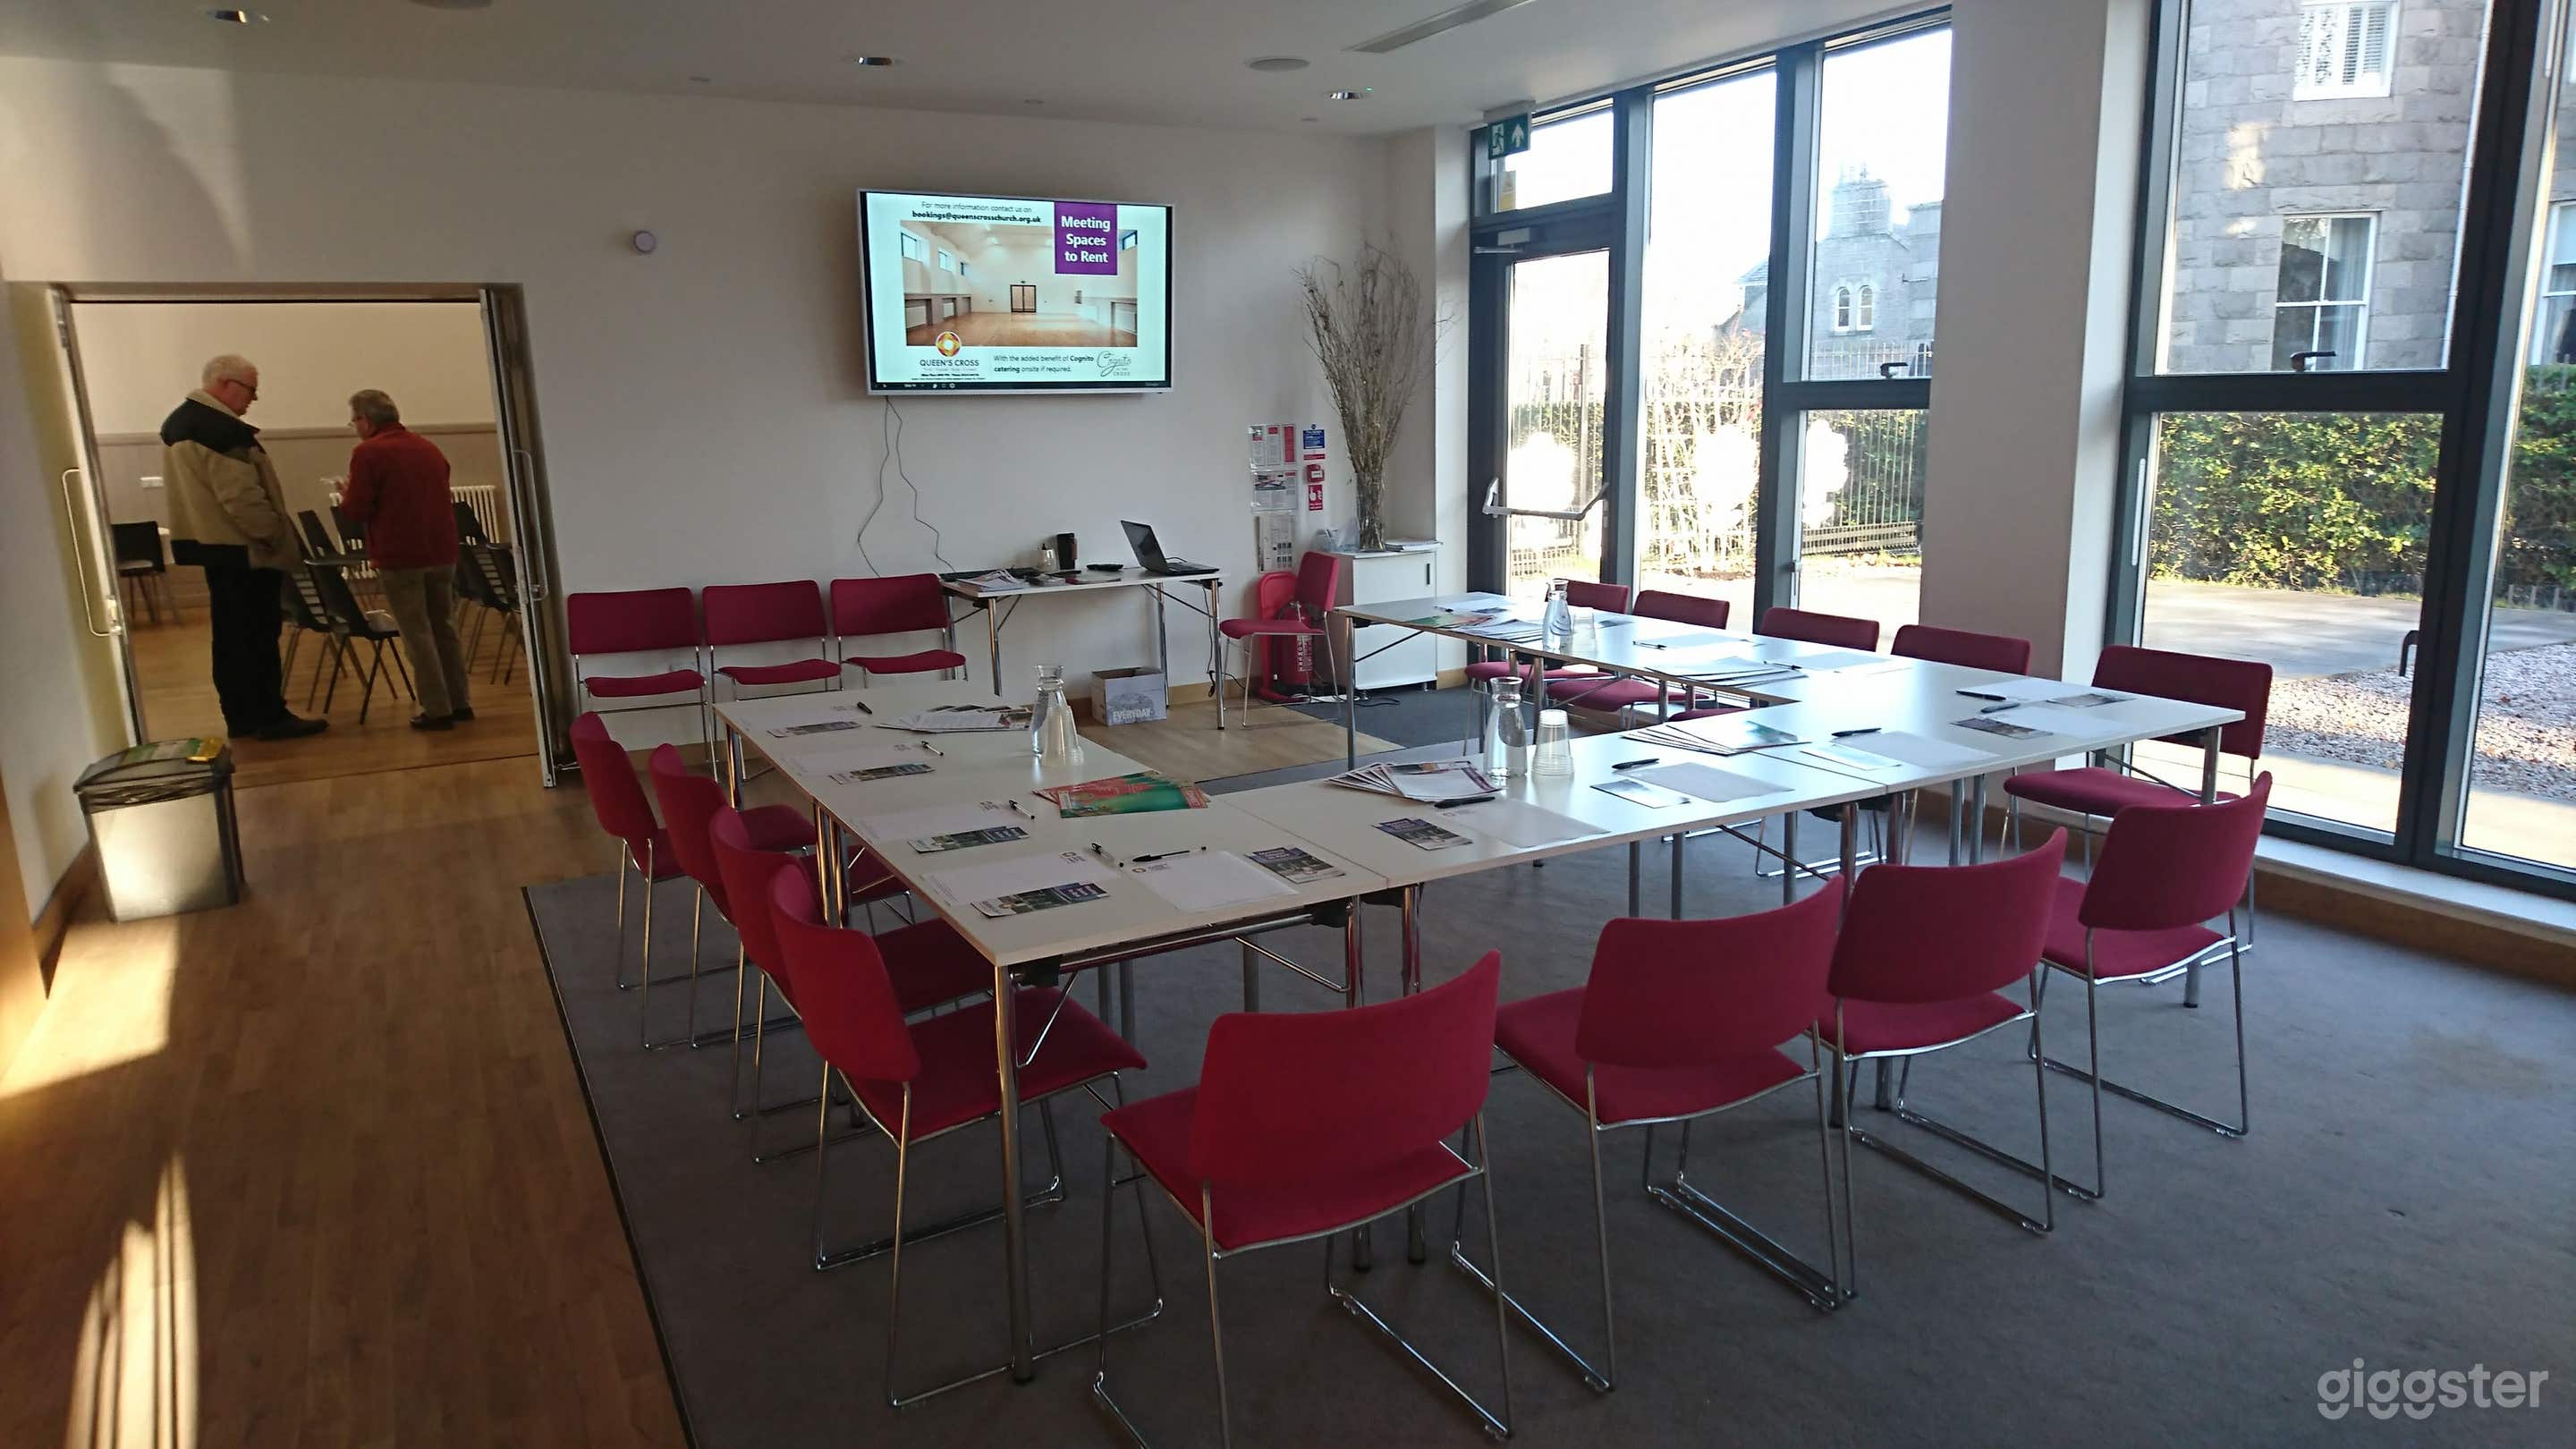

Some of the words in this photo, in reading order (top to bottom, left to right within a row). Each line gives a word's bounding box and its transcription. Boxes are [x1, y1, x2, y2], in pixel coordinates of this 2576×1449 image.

[953, 203, 989, 211] information
[911, 210, 1041, 223] bookings@queenscrosschurch.org.uk
[1061, 215, 1111, 233] Meeting
[1065, 233, 1107, 249] Spaces
[1064, 250, 1079, 262] to
[1080, 250, 1108, 263] Rent
[919, 359, 953, 367] QUEEN'S
[954, 359, 979, 367] CROSS
[994, 366, 1020, 374] catering
[1112, 708, 1151, 721] EVERYDAY
